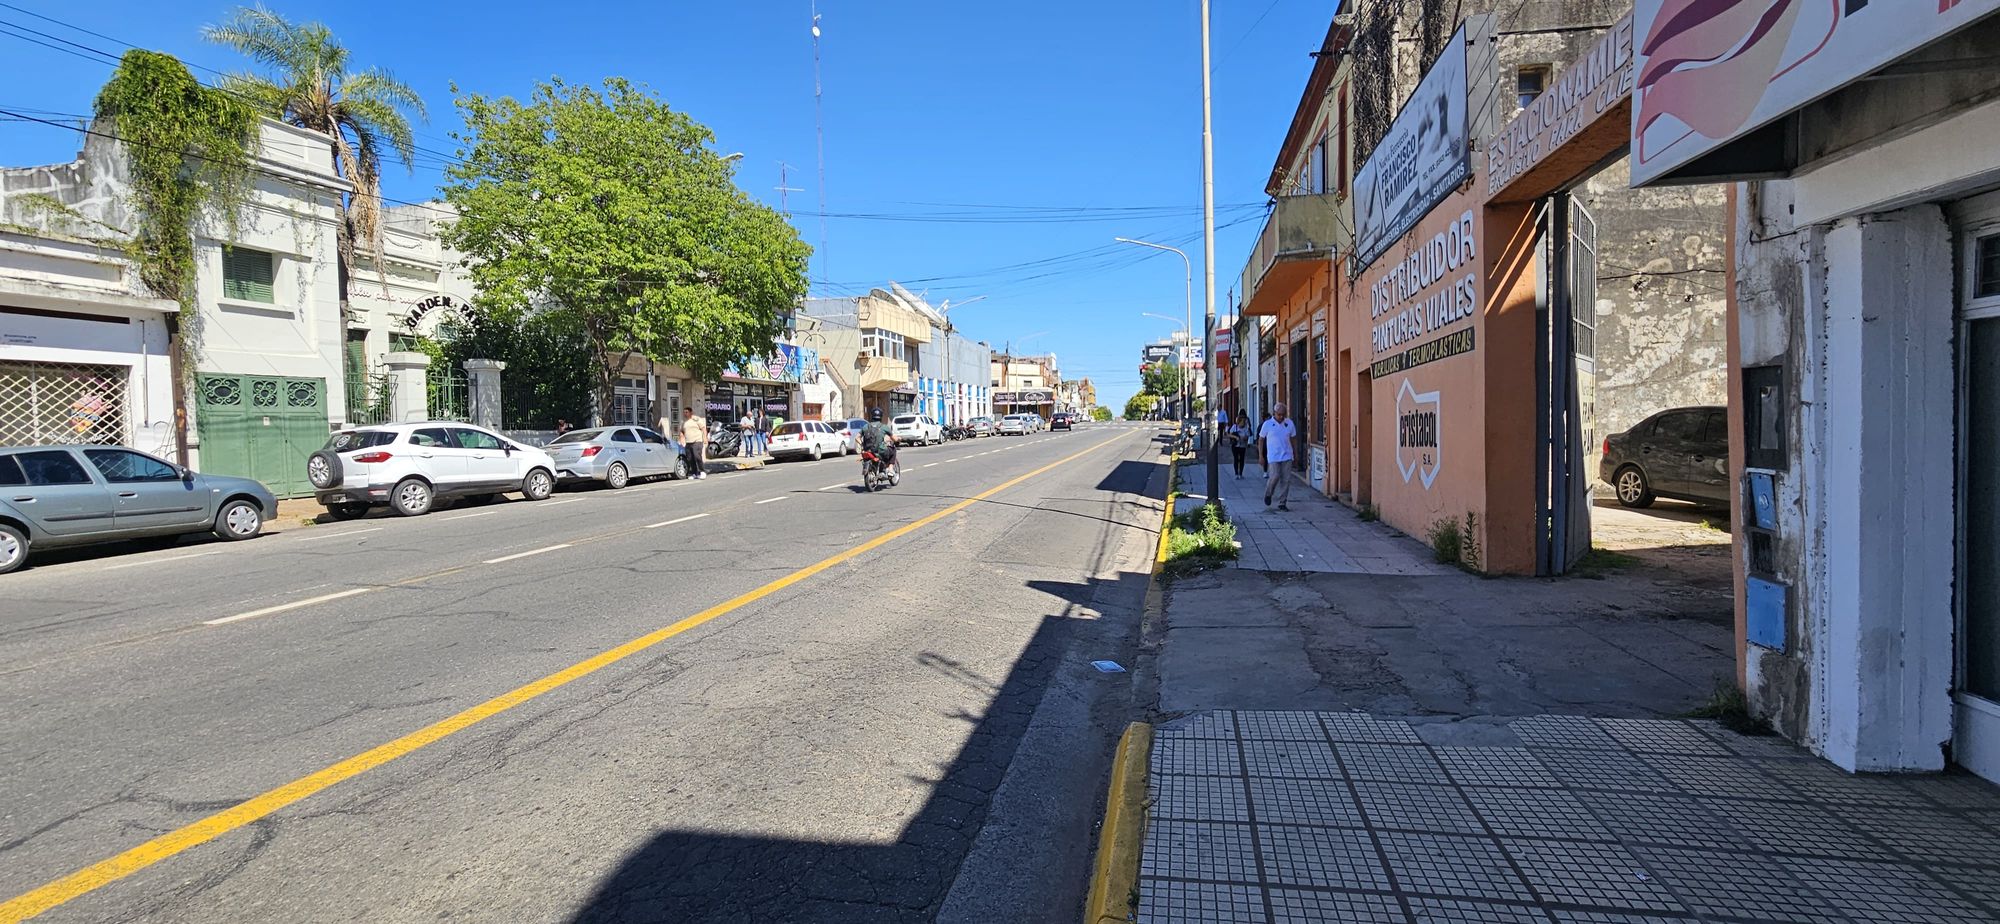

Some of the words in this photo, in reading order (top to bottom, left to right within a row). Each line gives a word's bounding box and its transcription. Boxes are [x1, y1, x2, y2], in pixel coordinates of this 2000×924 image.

[1549, 107, 1584, 152] PARA
[1381, 134, 1416, 190] FRANCISCO
[1384, 159, 1418, 210] RAMIREZ
[1401, 195, 1430, 229] ELECTRICIDAD
[1433, 161, 1465, 201] SANITARIOS
[1371, 209, 1475, 320] DISTRIBUIDOR
[406, 296, 451, 328] GARDEN
[1372, 301, 1422, 354] PINTURAS
[1425, 272, 1475, 333] VIALES
[1409, 329, 1472, 368] TERMOPLASTICAS
[704, 403, 731, 411] HORARIO
